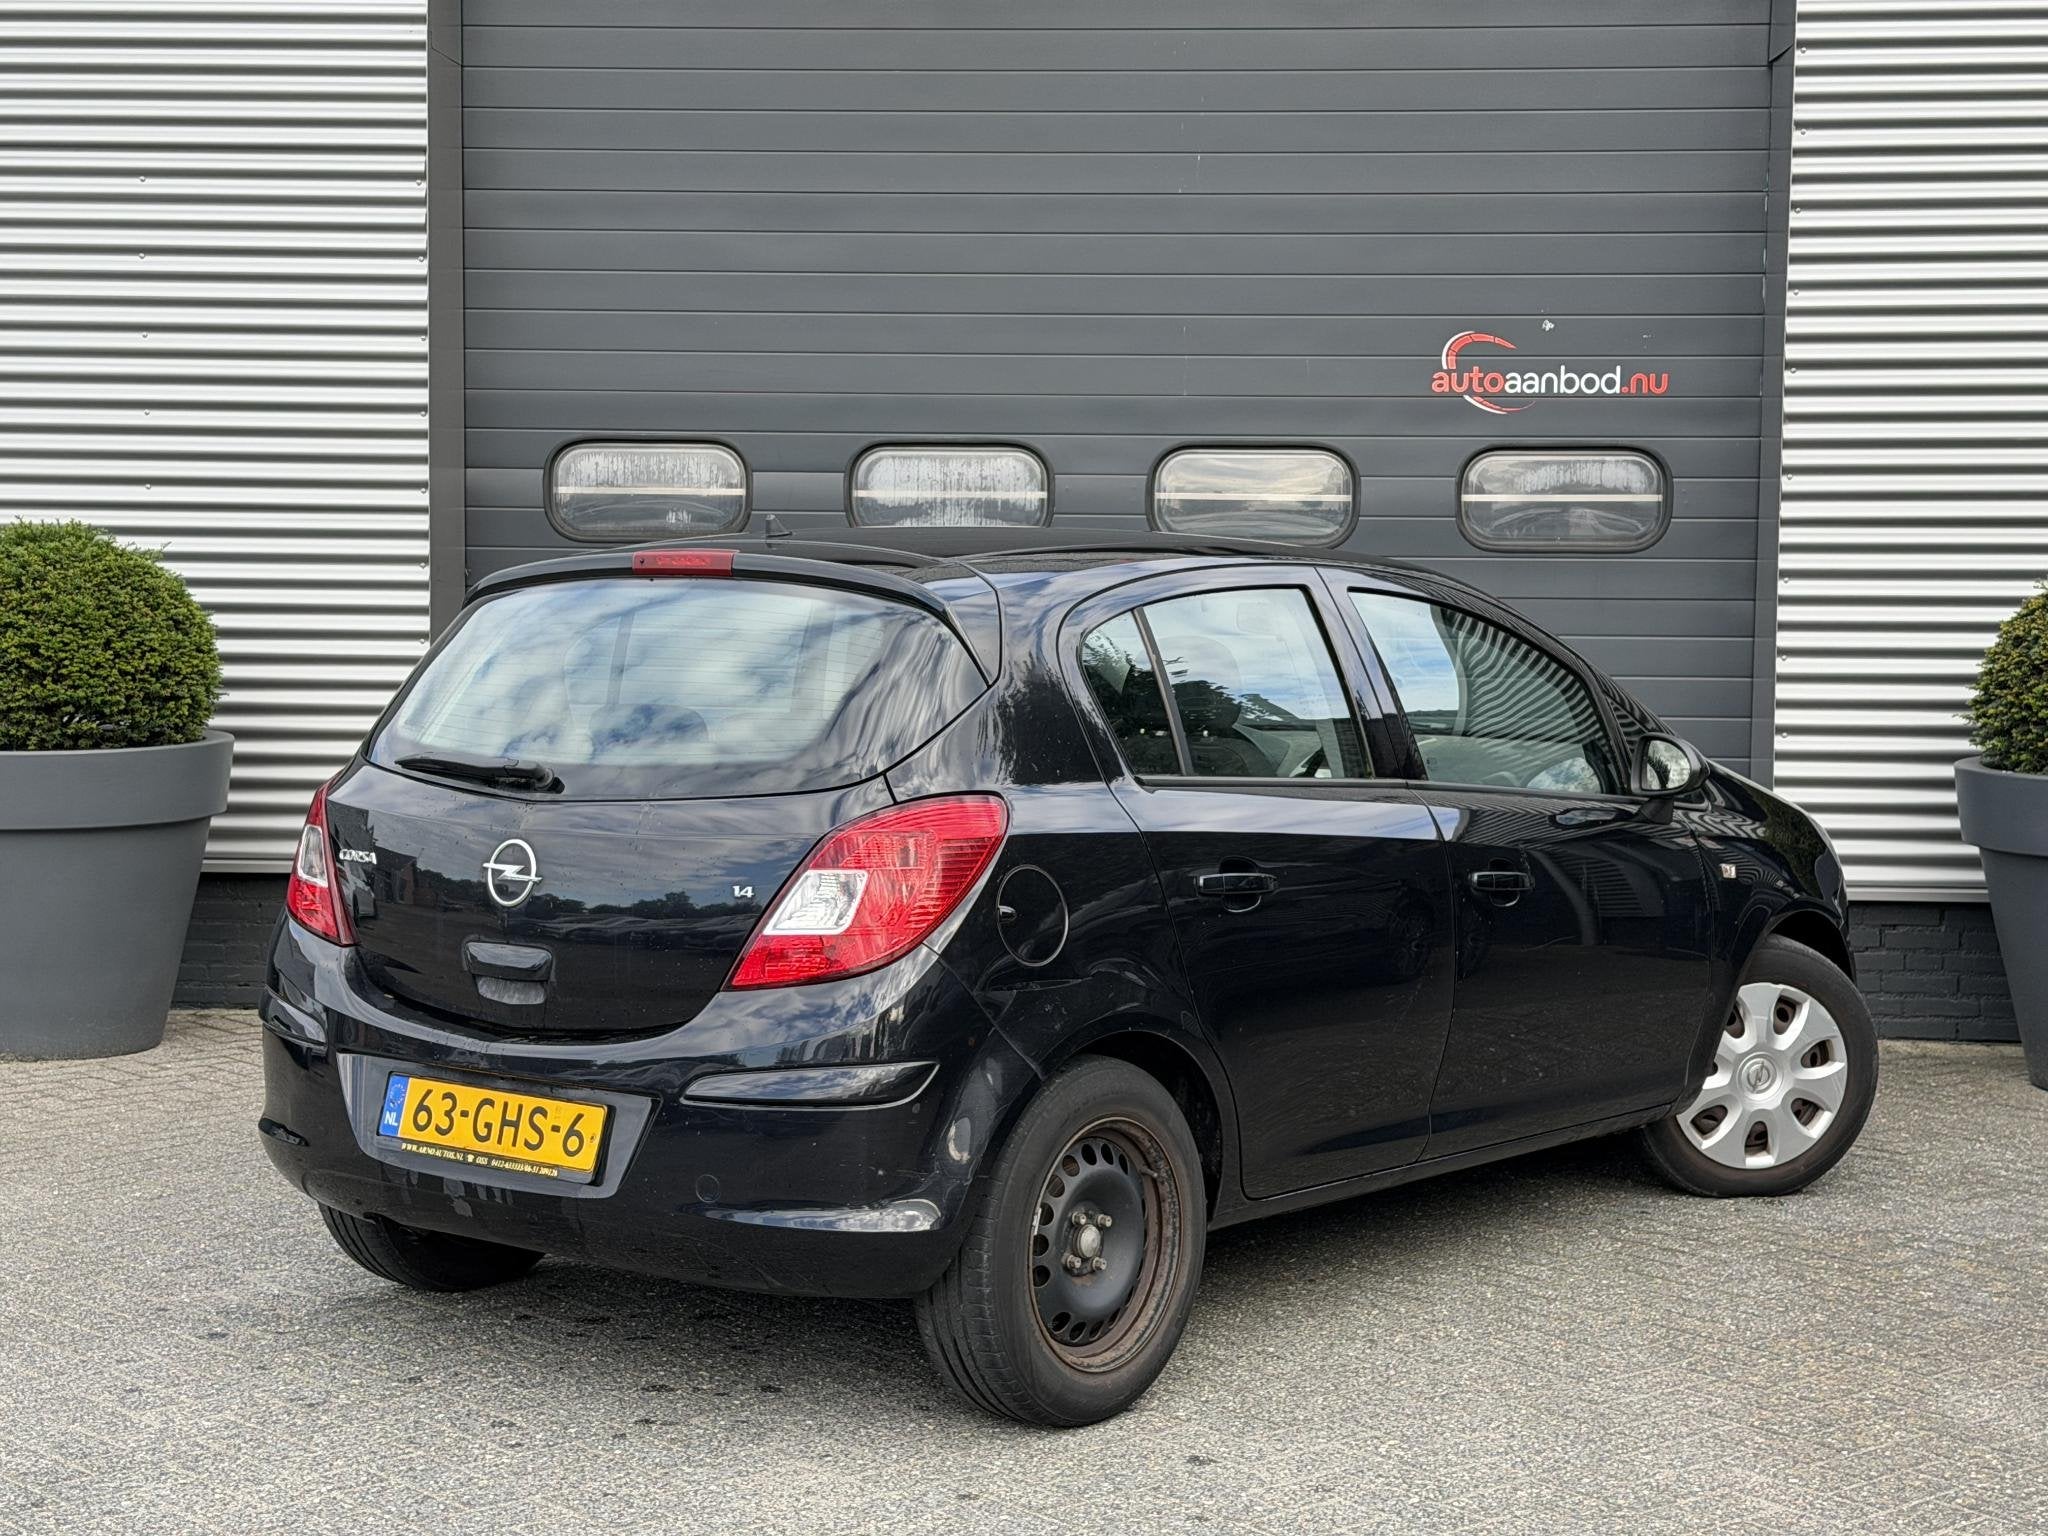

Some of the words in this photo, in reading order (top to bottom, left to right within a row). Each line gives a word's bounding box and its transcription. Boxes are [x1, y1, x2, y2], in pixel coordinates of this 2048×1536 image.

[1431, 365, 1670, 395] autoaanbod.nu
[339, 849, 377, 865] CORSA
[384, 1111, 399, 1127] NL
[412, 1088, 585, 1158] 63-GHS-6
